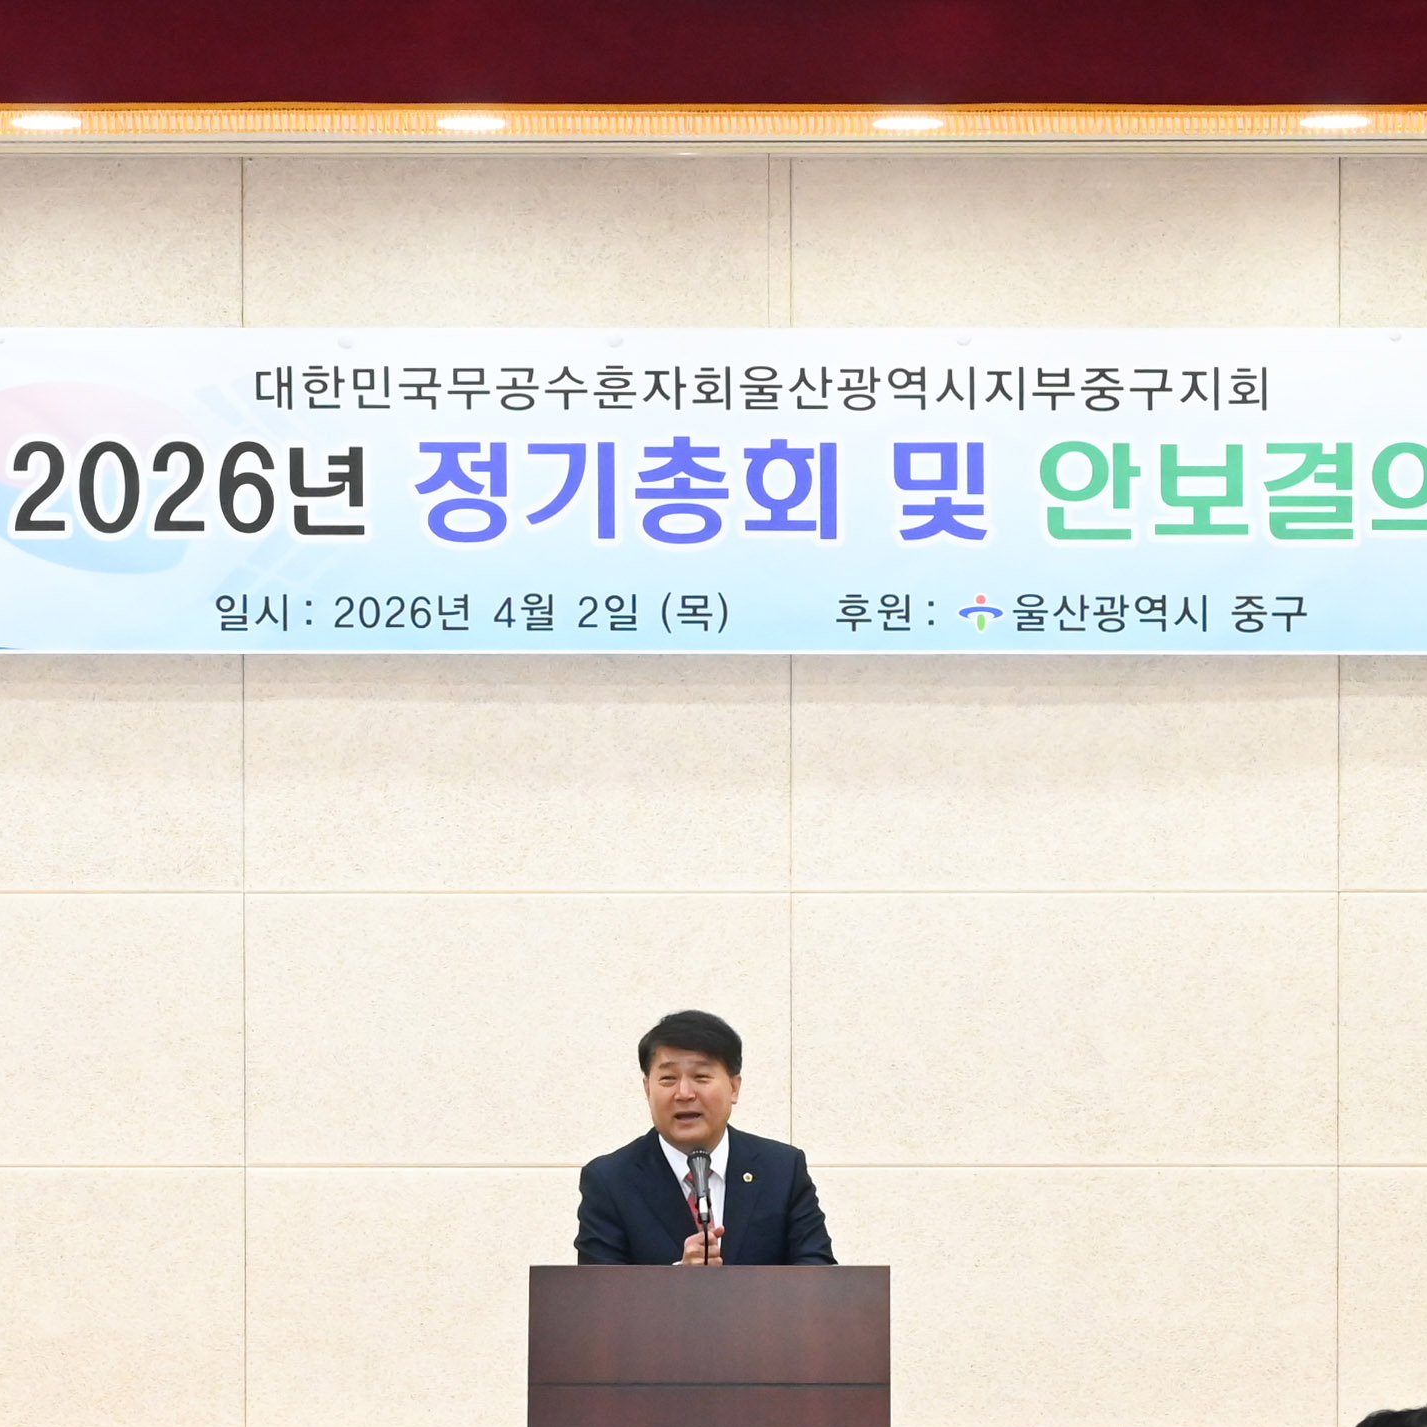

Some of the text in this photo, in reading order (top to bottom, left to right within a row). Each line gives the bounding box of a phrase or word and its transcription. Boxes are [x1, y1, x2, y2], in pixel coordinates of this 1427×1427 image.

[256, 366, 1267, 411] 대한민국무공수훈자회울산광역시지부중구지회
[13, 441, 365, 535] 2026년
[415, 436, 837, 544] 정기총회
[894, 442, 987, 540] 및
[335, 594, 469, 630] 2026년
[494, 593, 553, 631] 4월
[578, 594, 637, 631] 2일
[662, 592, 727, 633] (목)
[1013, 594, 1207, 632] 울산광역시
[1232, 596, 1307, 633] 중구
